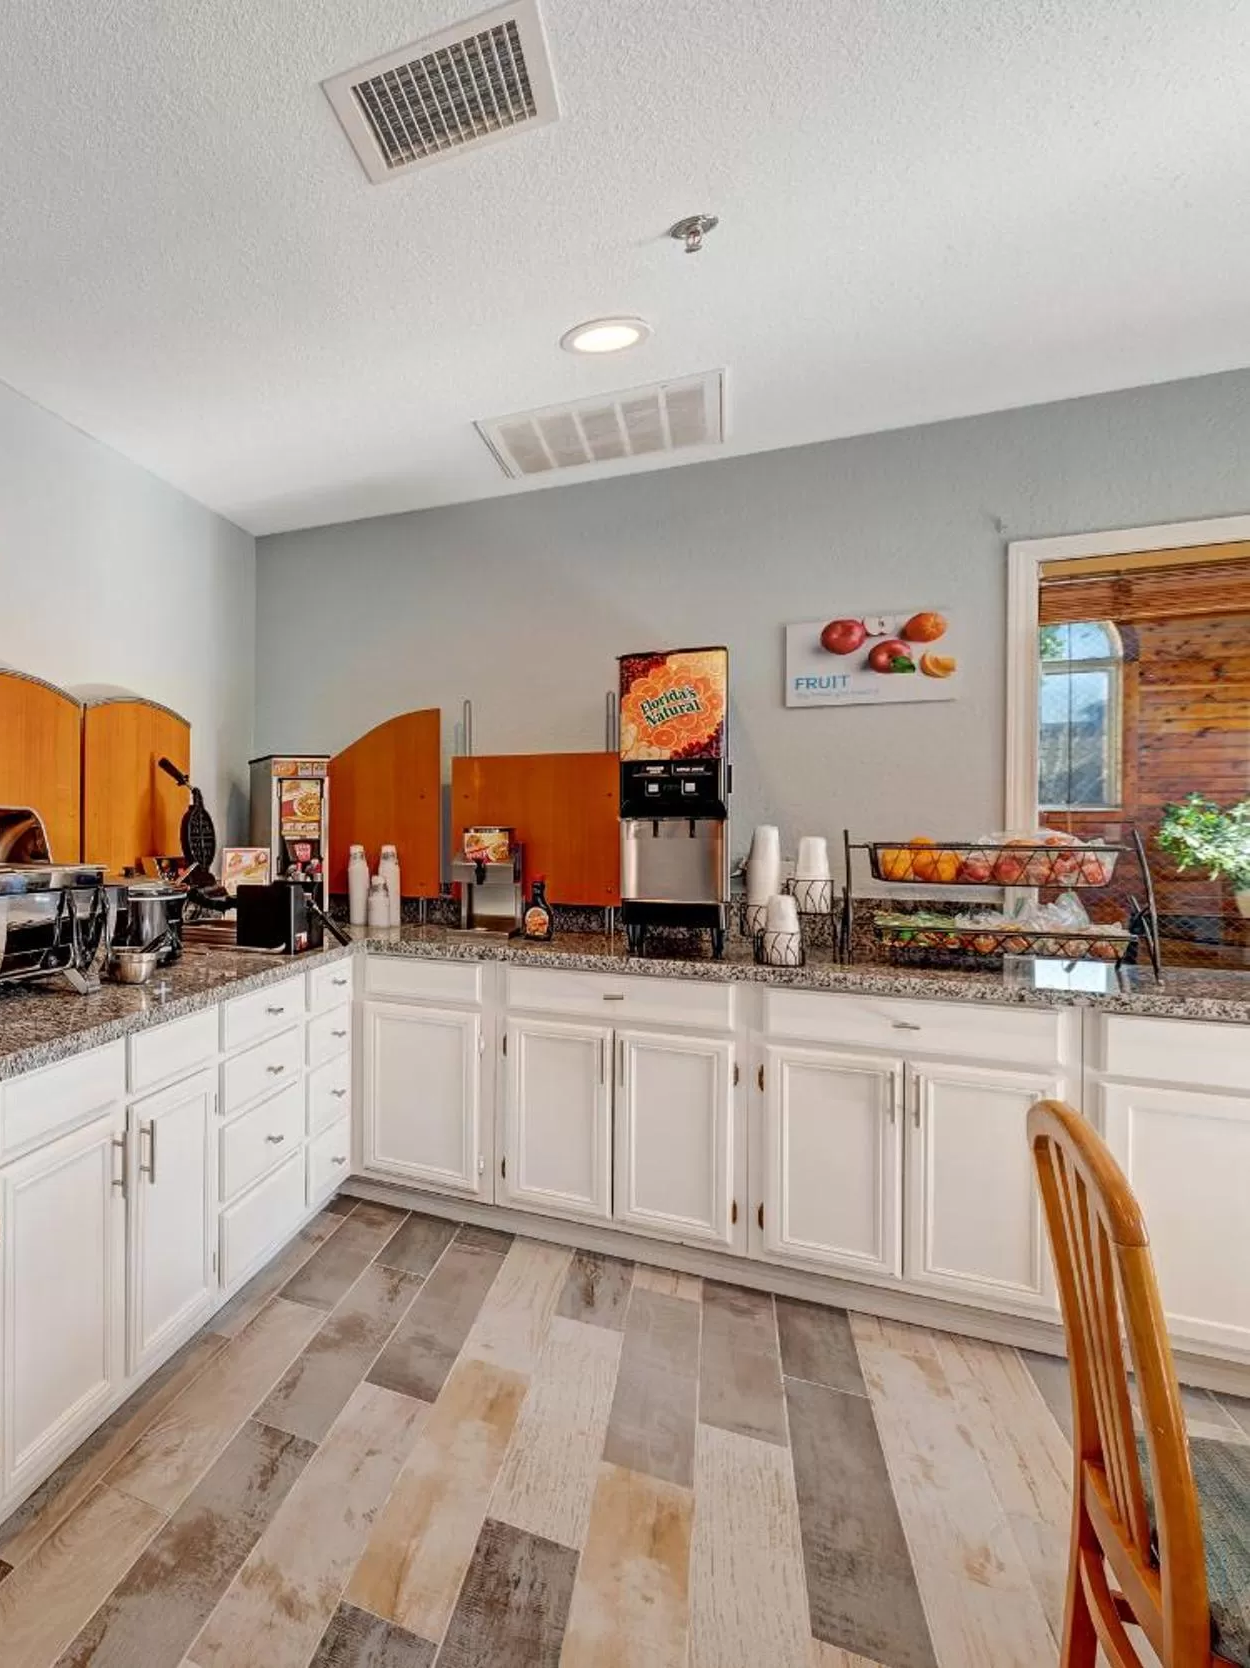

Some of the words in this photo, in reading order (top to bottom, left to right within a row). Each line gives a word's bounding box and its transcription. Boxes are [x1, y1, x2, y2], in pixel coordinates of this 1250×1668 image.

[794, 674, 851, 691] FRUIT
[639, 685, 698, 715] Florida's
[645, 699, 702, 727] Natural
